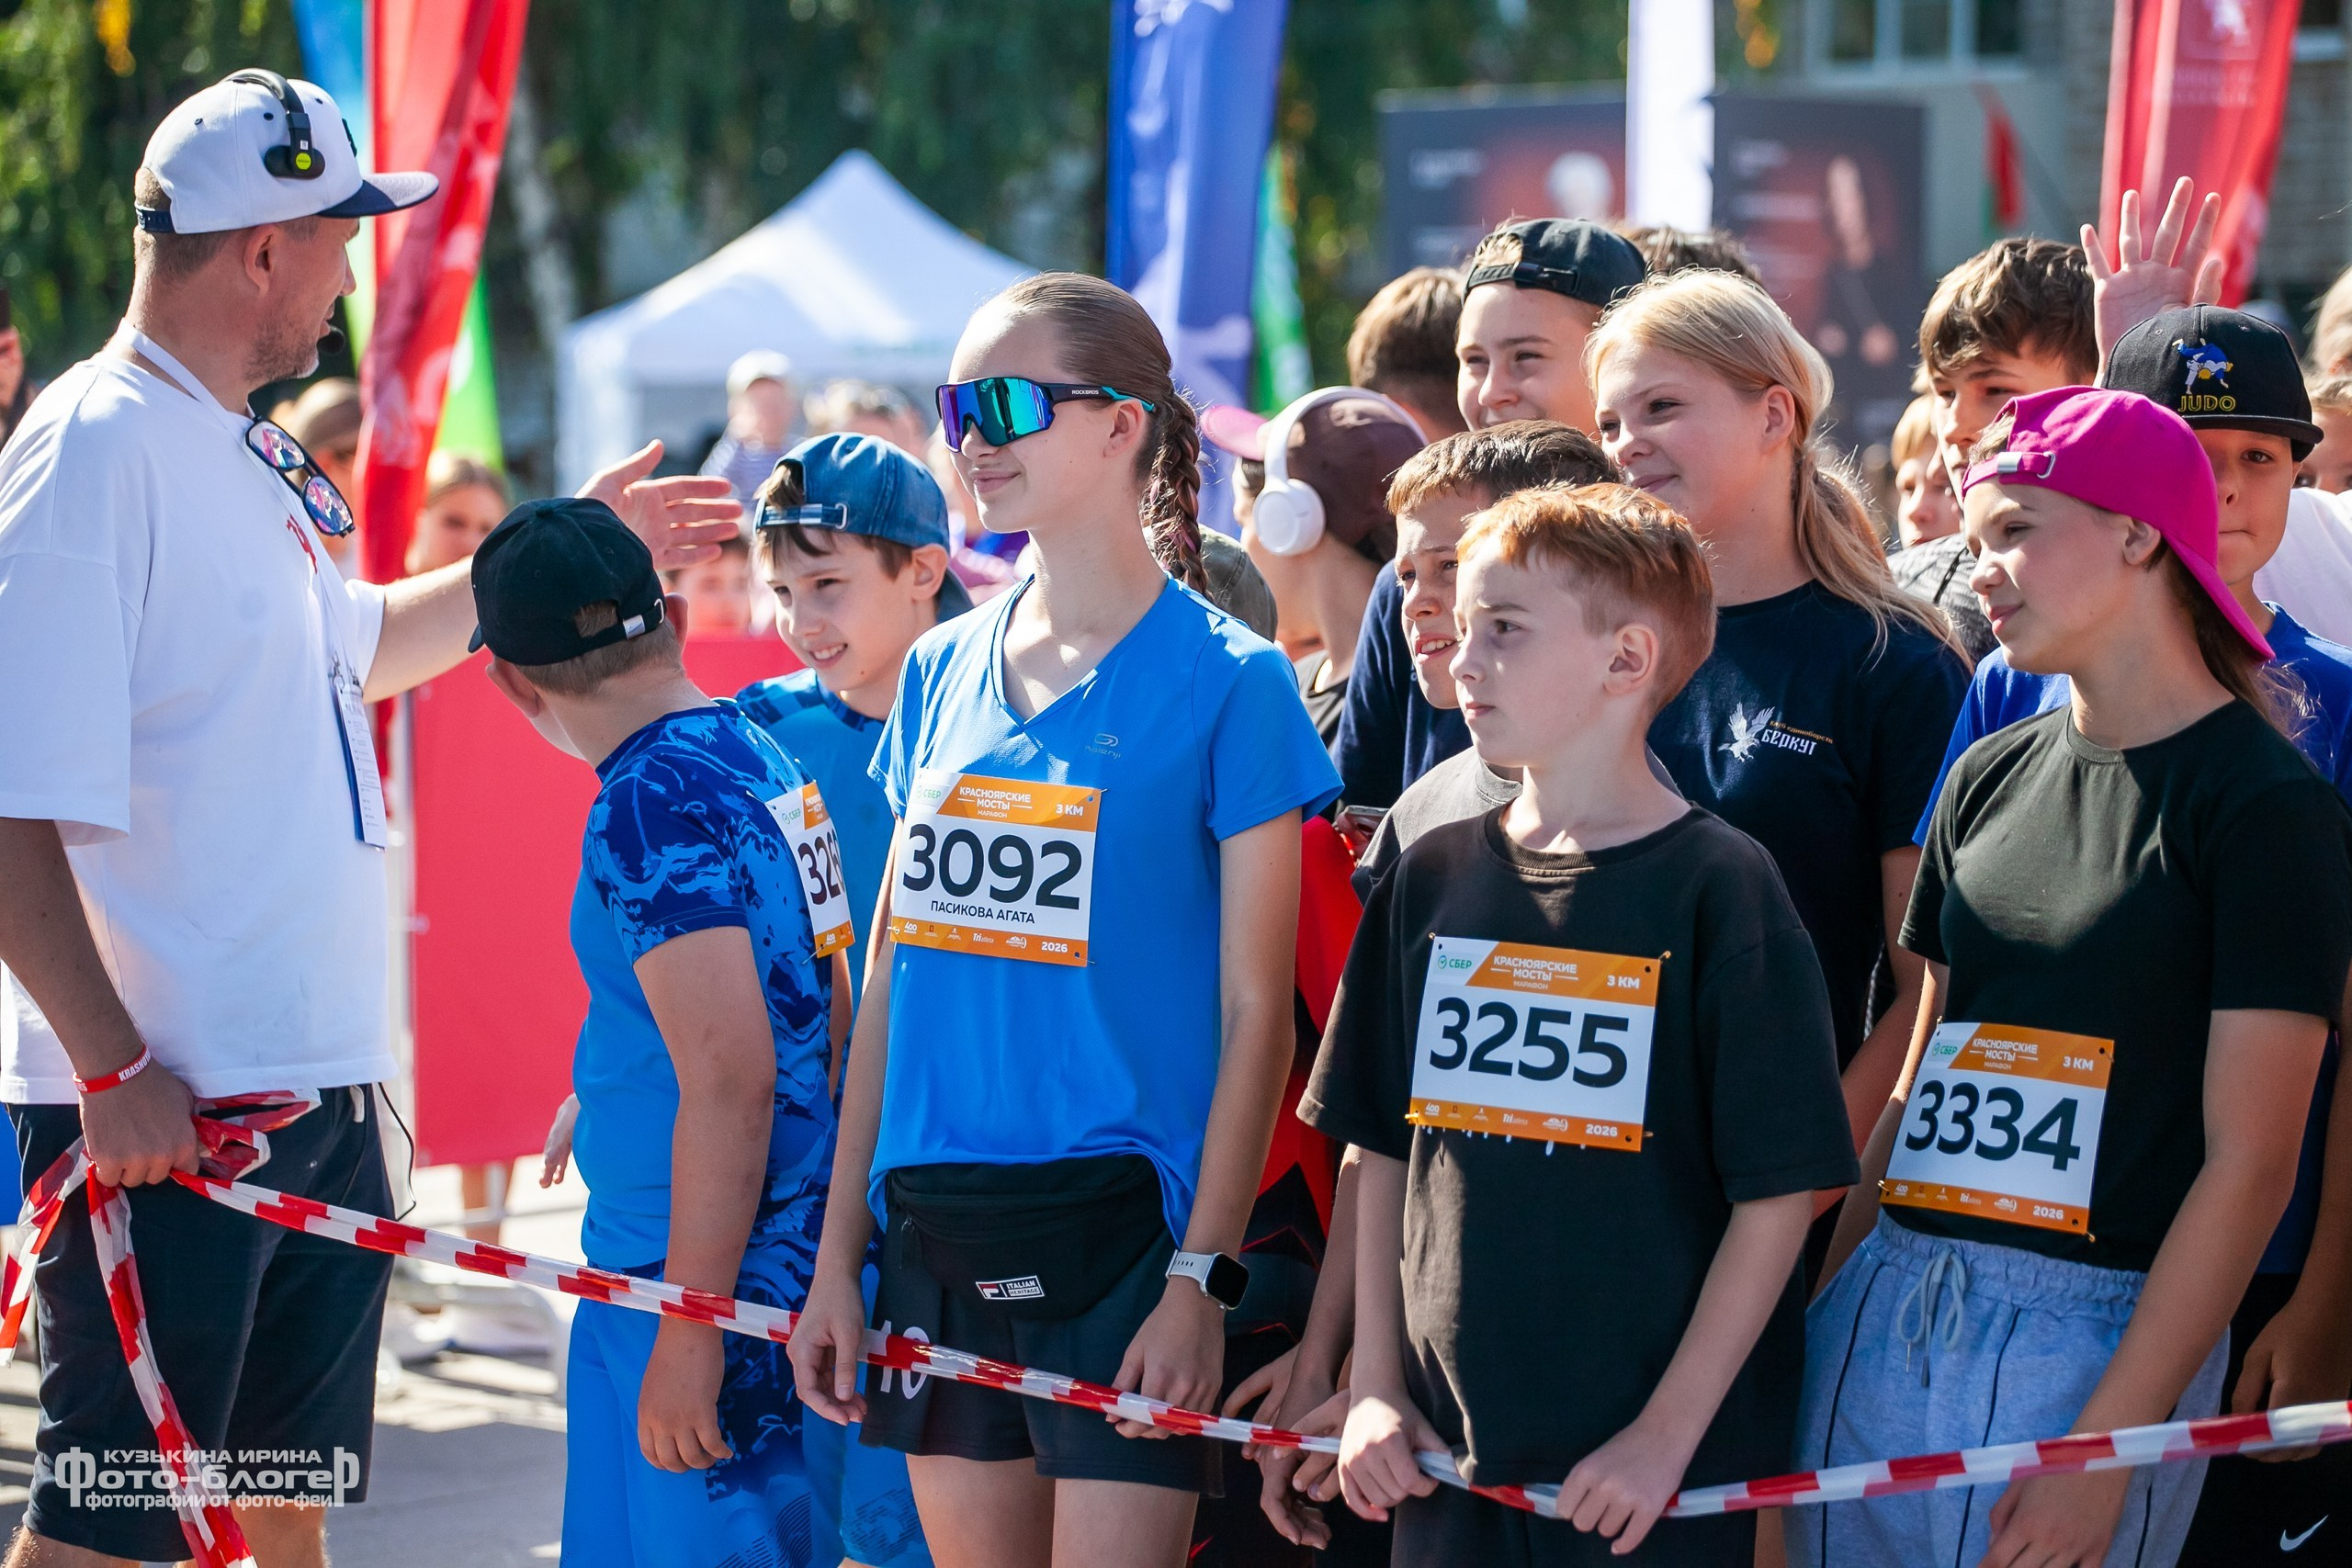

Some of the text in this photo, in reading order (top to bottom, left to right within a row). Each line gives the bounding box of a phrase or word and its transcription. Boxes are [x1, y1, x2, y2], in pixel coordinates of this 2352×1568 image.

[2177, 395, 2236, 412] JUDO
[923, 789, 942, 799] СБЕР
[959, 786, 1031, 803] КРАСНОЯРСКИЕ
[977, 798, 1011, 810] МОСТЫ
[1056, 805, 1083, 816] 3 КМ
[977, 809, 1008, 818] МАРАФОН
[797, 829, 845, 906] 326
[902, 824, 1082, 910] 3092
[931, 900, 1035, 924] ПАСИКОВА АГАТА
[1041, 942, 1068, 953] 2026
[1449, 958, 1472, 969] СБЕР
[1493, 955, 1577, 974] КРАСНОЯРСКИЕ
[1512, 968, 1552, 981] МОСТЫ
[1513, 980, 1548, 990] МАРАФОН
[1607, 976, 1640, 988] 3 КМ
[1429, 997, 1630, 1089] 3255
[1972, 1038, 2039, 1055] КРАСНОЯРСКИЕ
[1939, 1045, 1958, 1055] СБЕР
[1984, 1049, 2016, 1062] МОСТЫ
[2063, 1056, 2094, 1071] 3 КМ
[1585, 1123, 1618, 1137] 2026
[1905, 1079, 2081, 1171] 3334
[2032, 1205, 2064, 1220] 2026
[1006, 1280, 1035, 1290] ITALIAN
